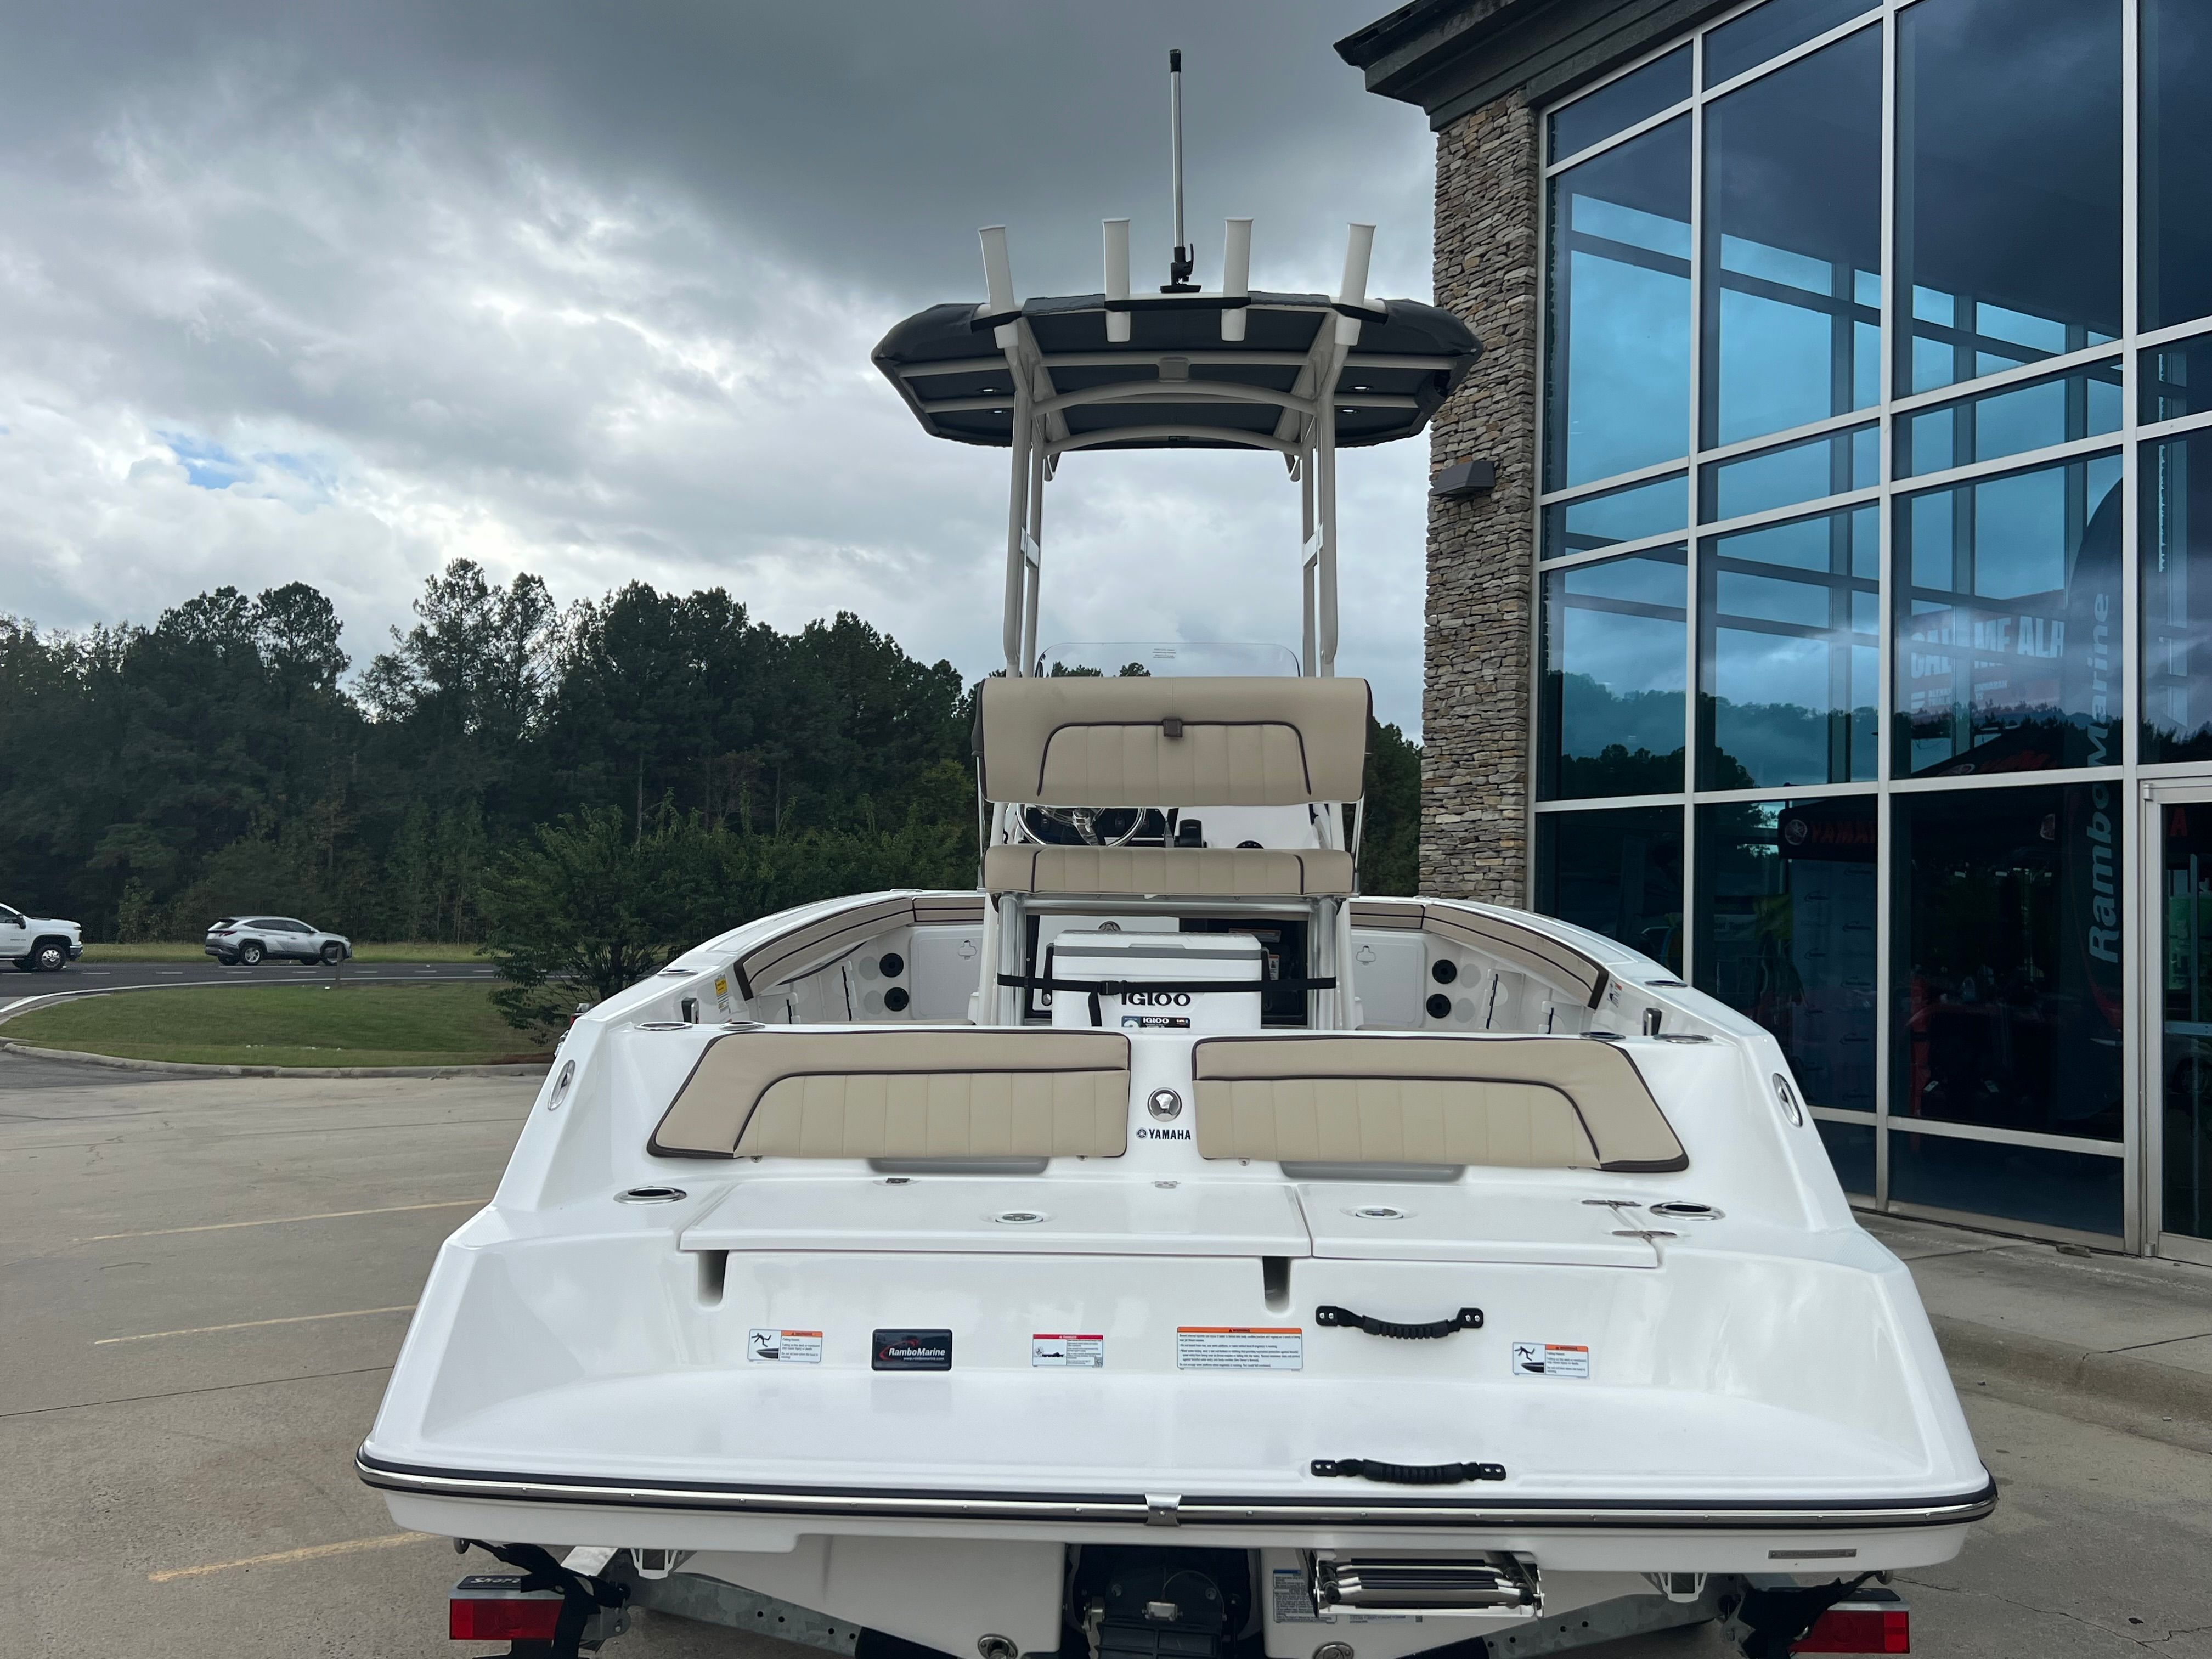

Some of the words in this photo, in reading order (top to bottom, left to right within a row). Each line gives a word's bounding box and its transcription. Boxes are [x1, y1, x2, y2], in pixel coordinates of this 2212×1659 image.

[2087, 592, 2119, 964] RamboMarine
[1121, 992, 1191, 1006] IGLOO
[1149, 1128, 1191, 1140] YAMAHA
[889, 1347, 945, 1356] RamboMarine
